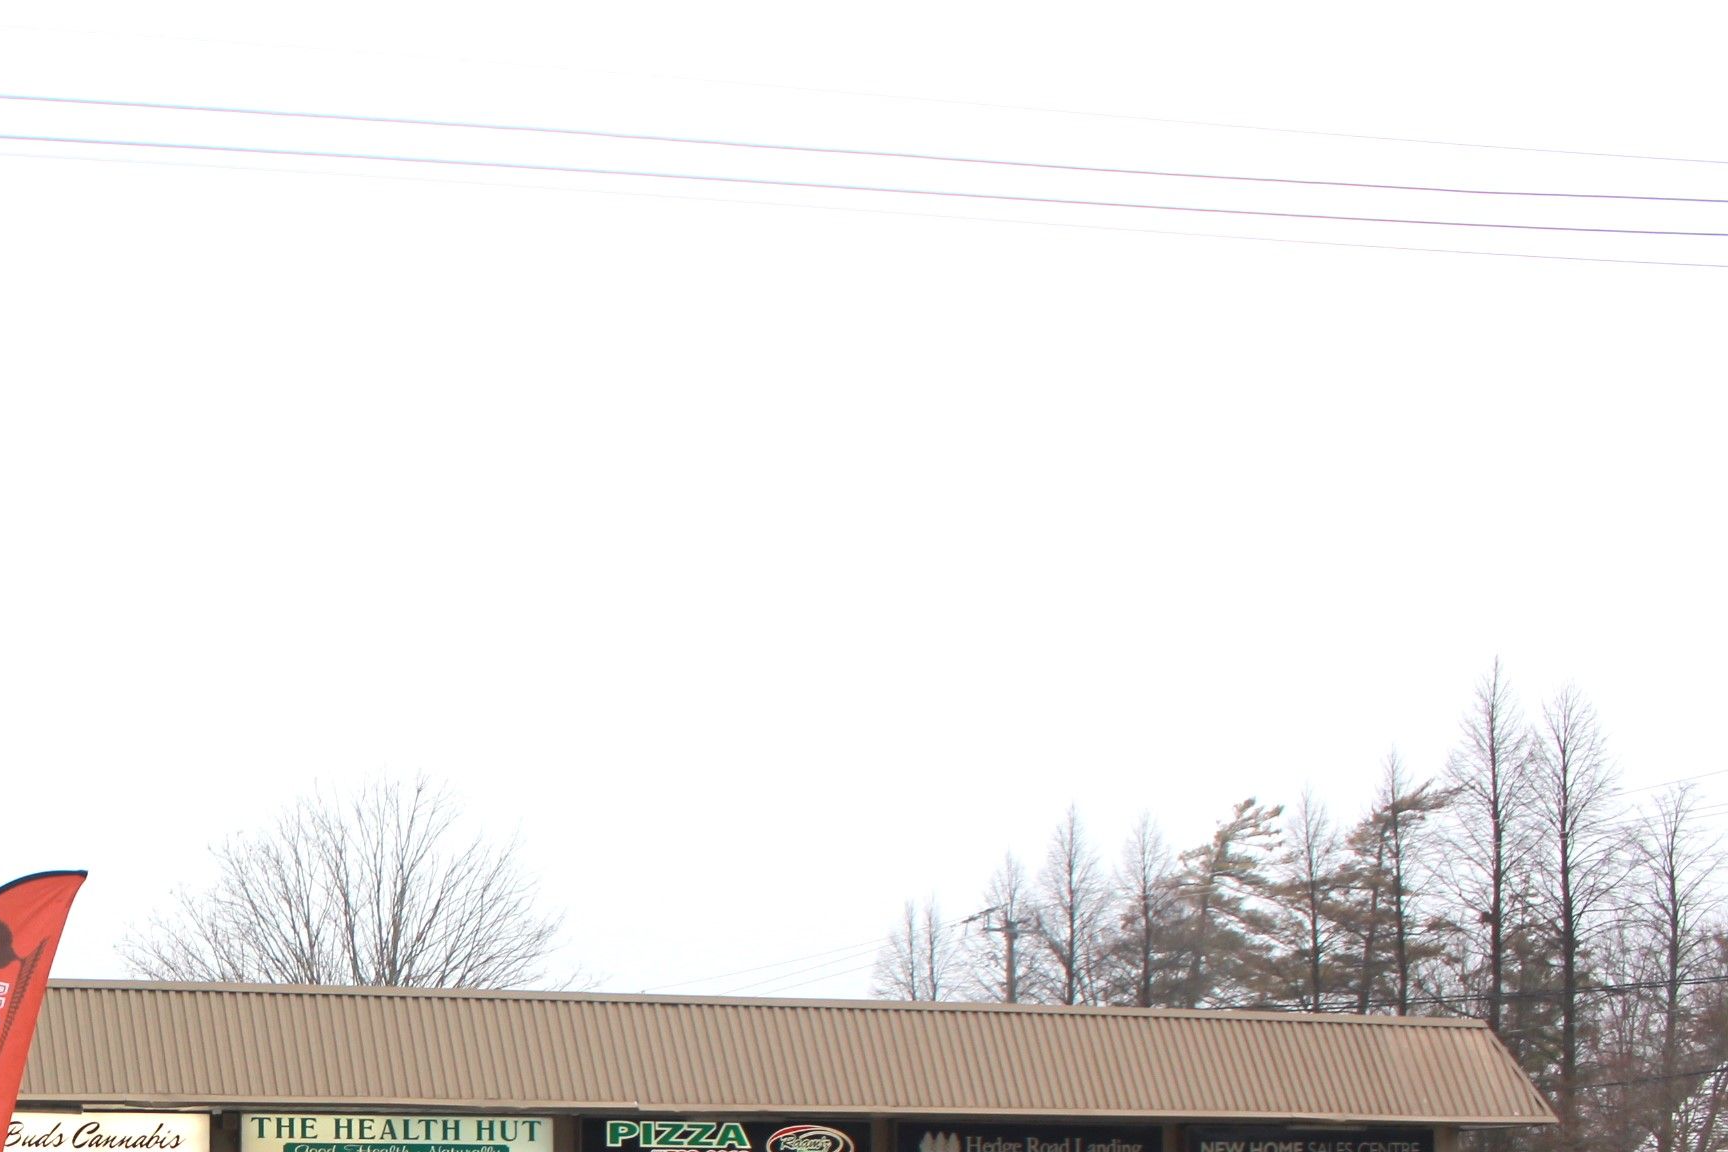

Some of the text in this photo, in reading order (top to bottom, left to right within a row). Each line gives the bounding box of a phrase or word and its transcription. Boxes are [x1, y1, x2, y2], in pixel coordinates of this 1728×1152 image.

[3, 1120, 186, 1149] Buds Cannabis
[251, 1117, 542, 1142] THE HEALTH HUT
[606, 1120, 752, 1149] PIZZA
